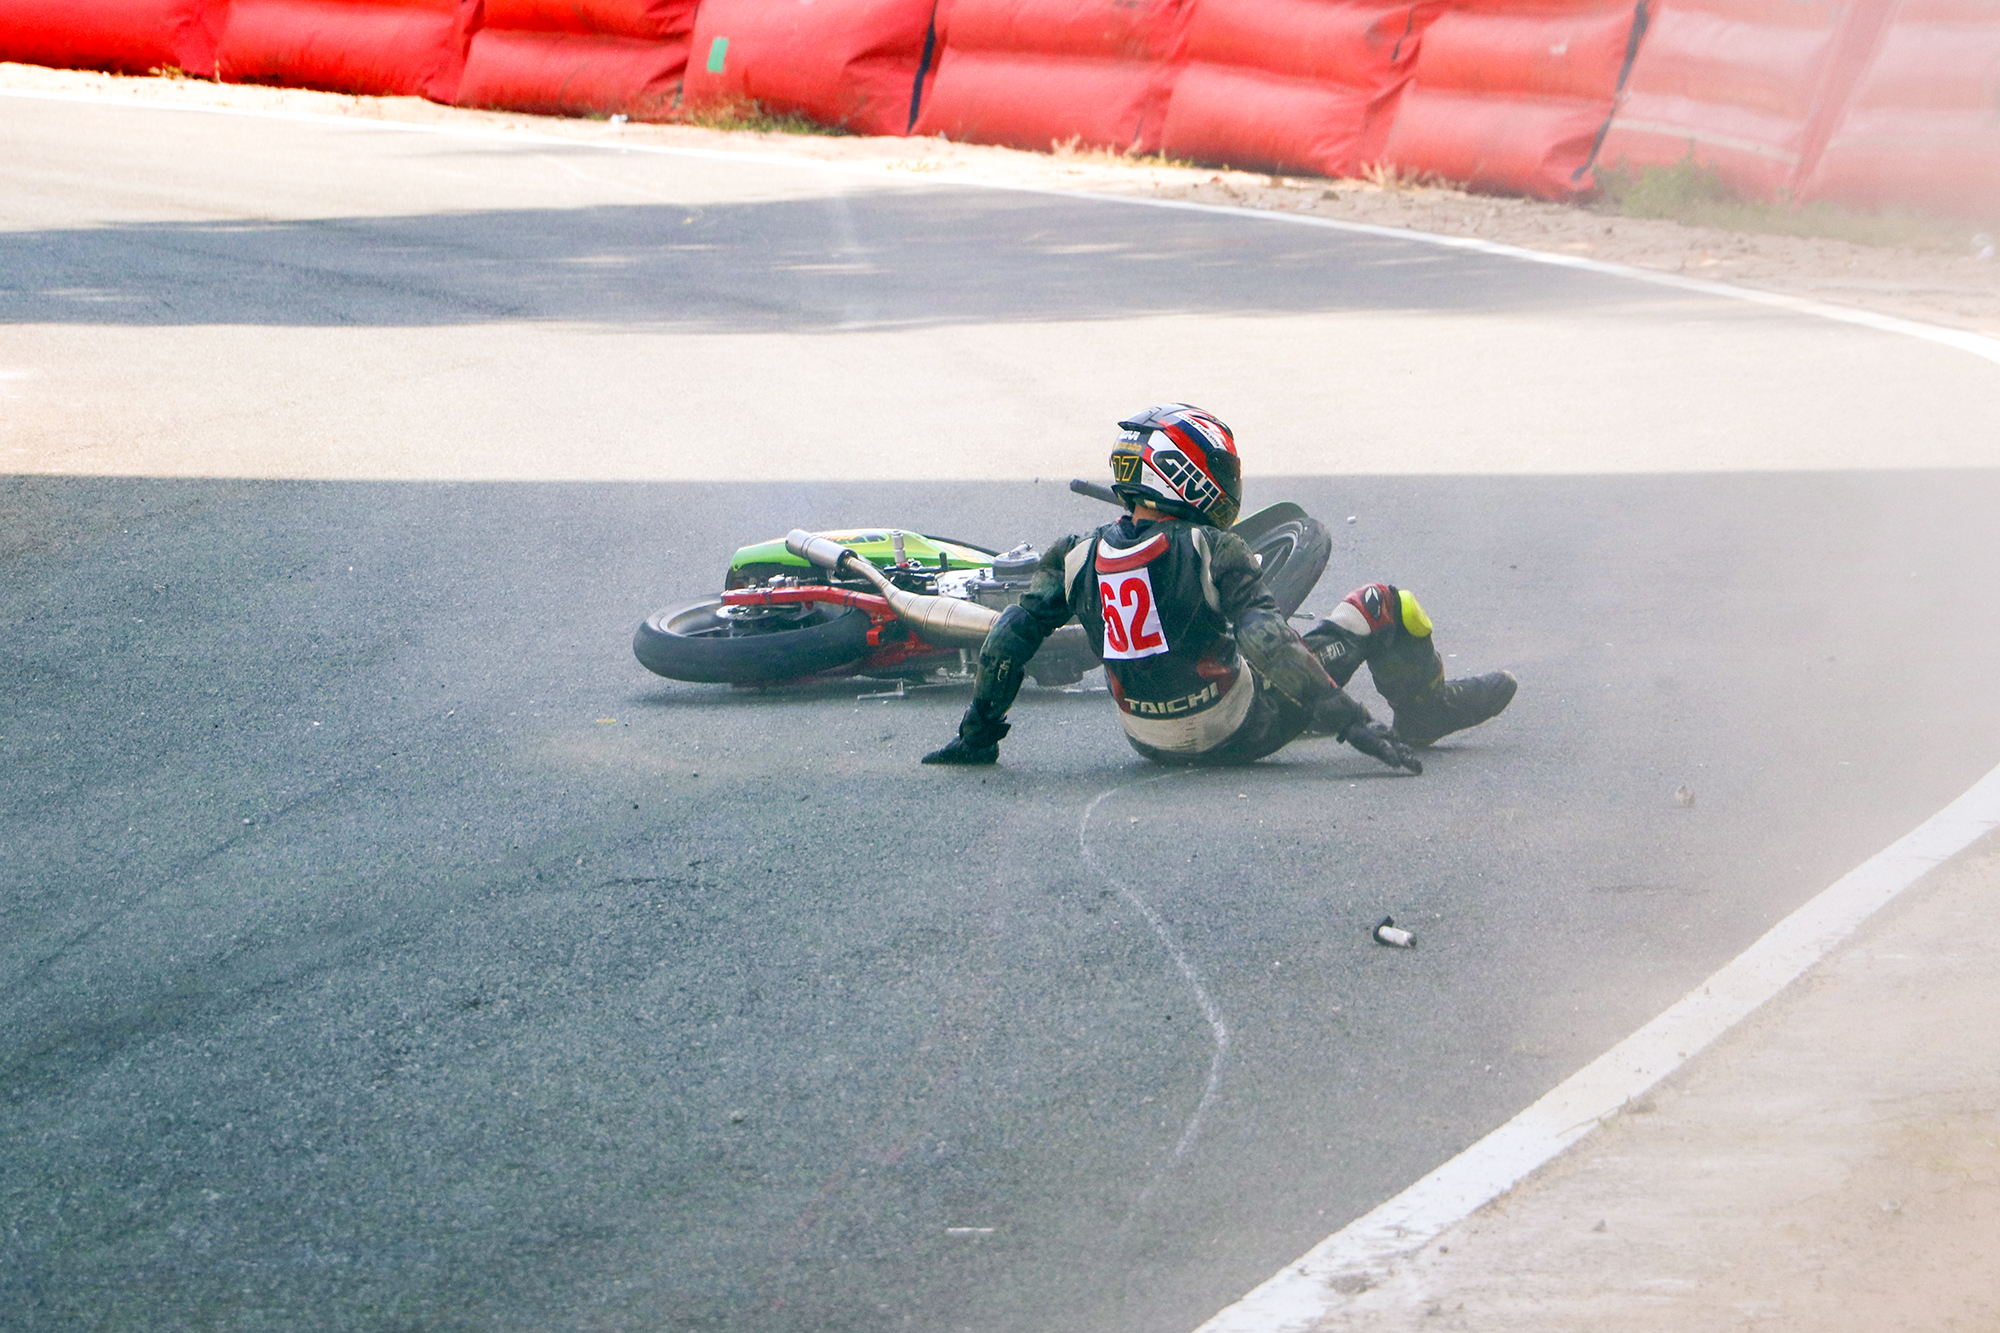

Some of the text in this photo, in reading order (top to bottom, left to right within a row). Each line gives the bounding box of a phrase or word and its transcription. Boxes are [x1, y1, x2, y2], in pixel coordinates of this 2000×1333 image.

[1150, 449, 1222, 513] GIVI
[1100, 577, 1163, 653] 62
[1123, 681, 1220, 715] TAICHI
